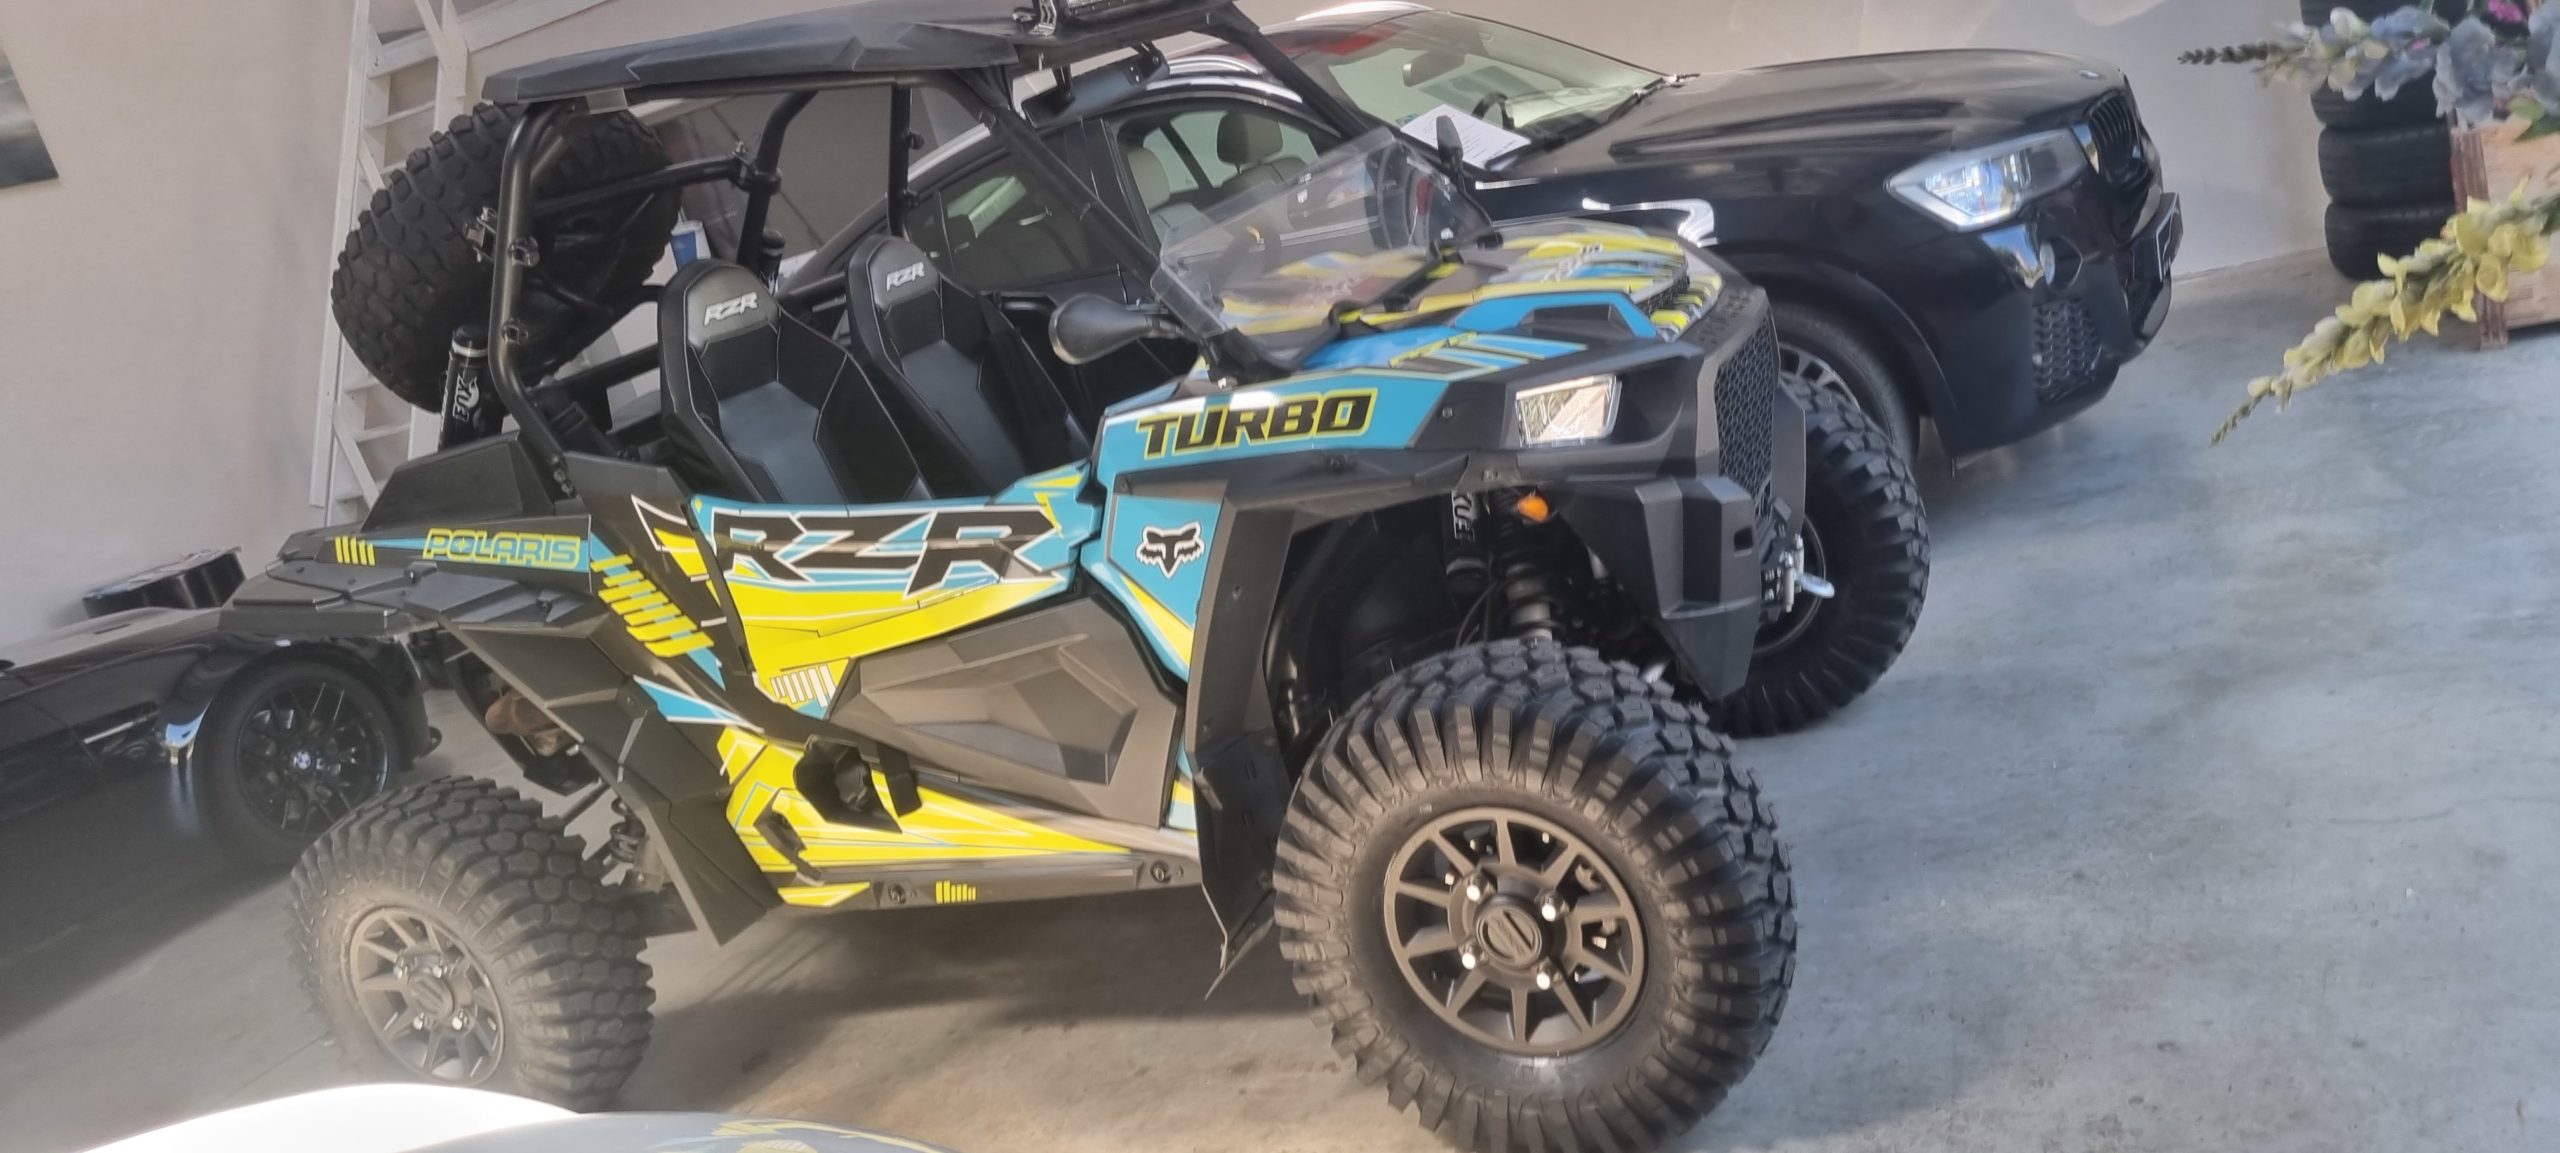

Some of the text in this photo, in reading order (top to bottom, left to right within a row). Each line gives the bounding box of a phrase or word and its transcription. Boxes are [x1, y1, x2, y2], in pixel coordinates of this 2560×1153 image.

[888, 262, 926, 291] RZR
[704, 292, 758, 327] RZR
[452, 373, 479, 422] FOX
[1136, 388, 1378, 460] TURBO
[423, 528, 580, 569] POLARIS
[708, 503, 1064, 600] RZR
